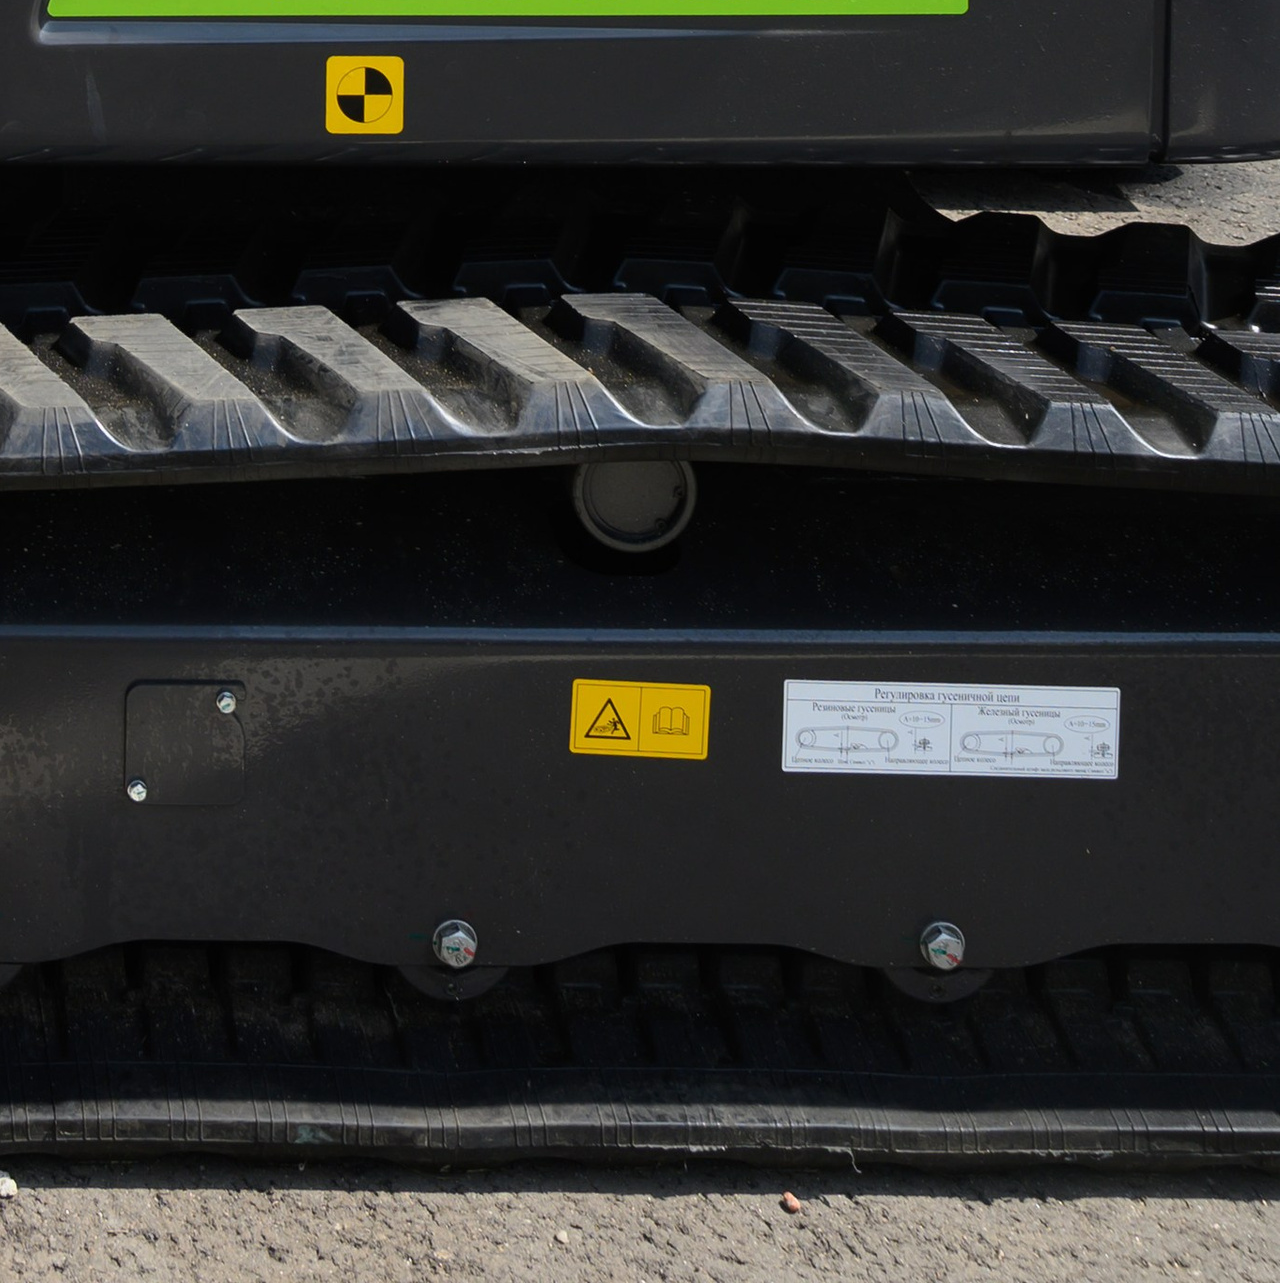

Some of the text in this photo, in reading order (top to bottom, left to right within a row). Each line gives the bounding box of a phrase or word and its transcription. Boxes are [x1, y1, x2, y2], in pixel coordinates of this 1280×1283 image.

[874, 688, 1020, 704] Регулировка гусеничной цепи
[812, 702, 896, 715] Резиновые гусеницы
[978, 706, 1060, 719] Железный гусеницы
